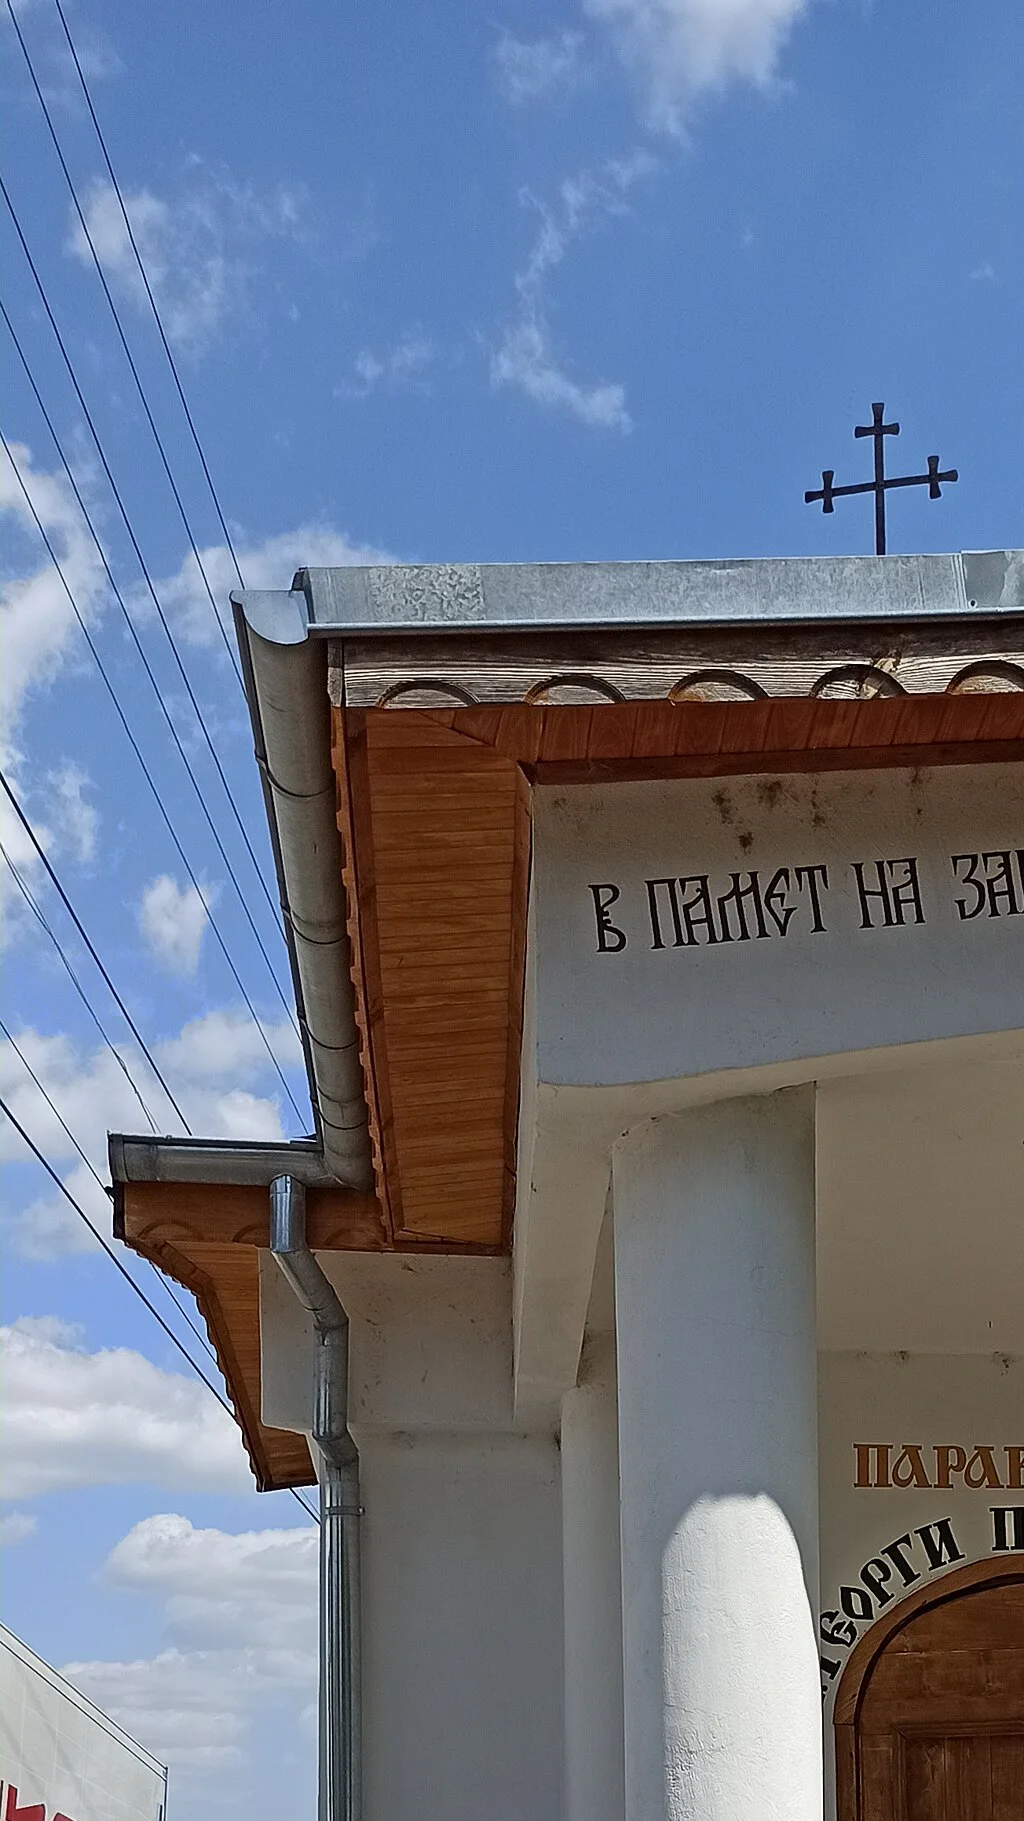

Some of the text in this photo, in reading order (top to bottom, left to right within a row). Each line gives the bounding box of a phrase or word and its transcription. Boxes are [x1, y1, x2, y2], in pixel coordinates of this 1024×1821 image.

[587, 883, 627, 953] В
[645, 865, 828, 950] ПАМЕТ
[855, 857, 925, 929] НА
